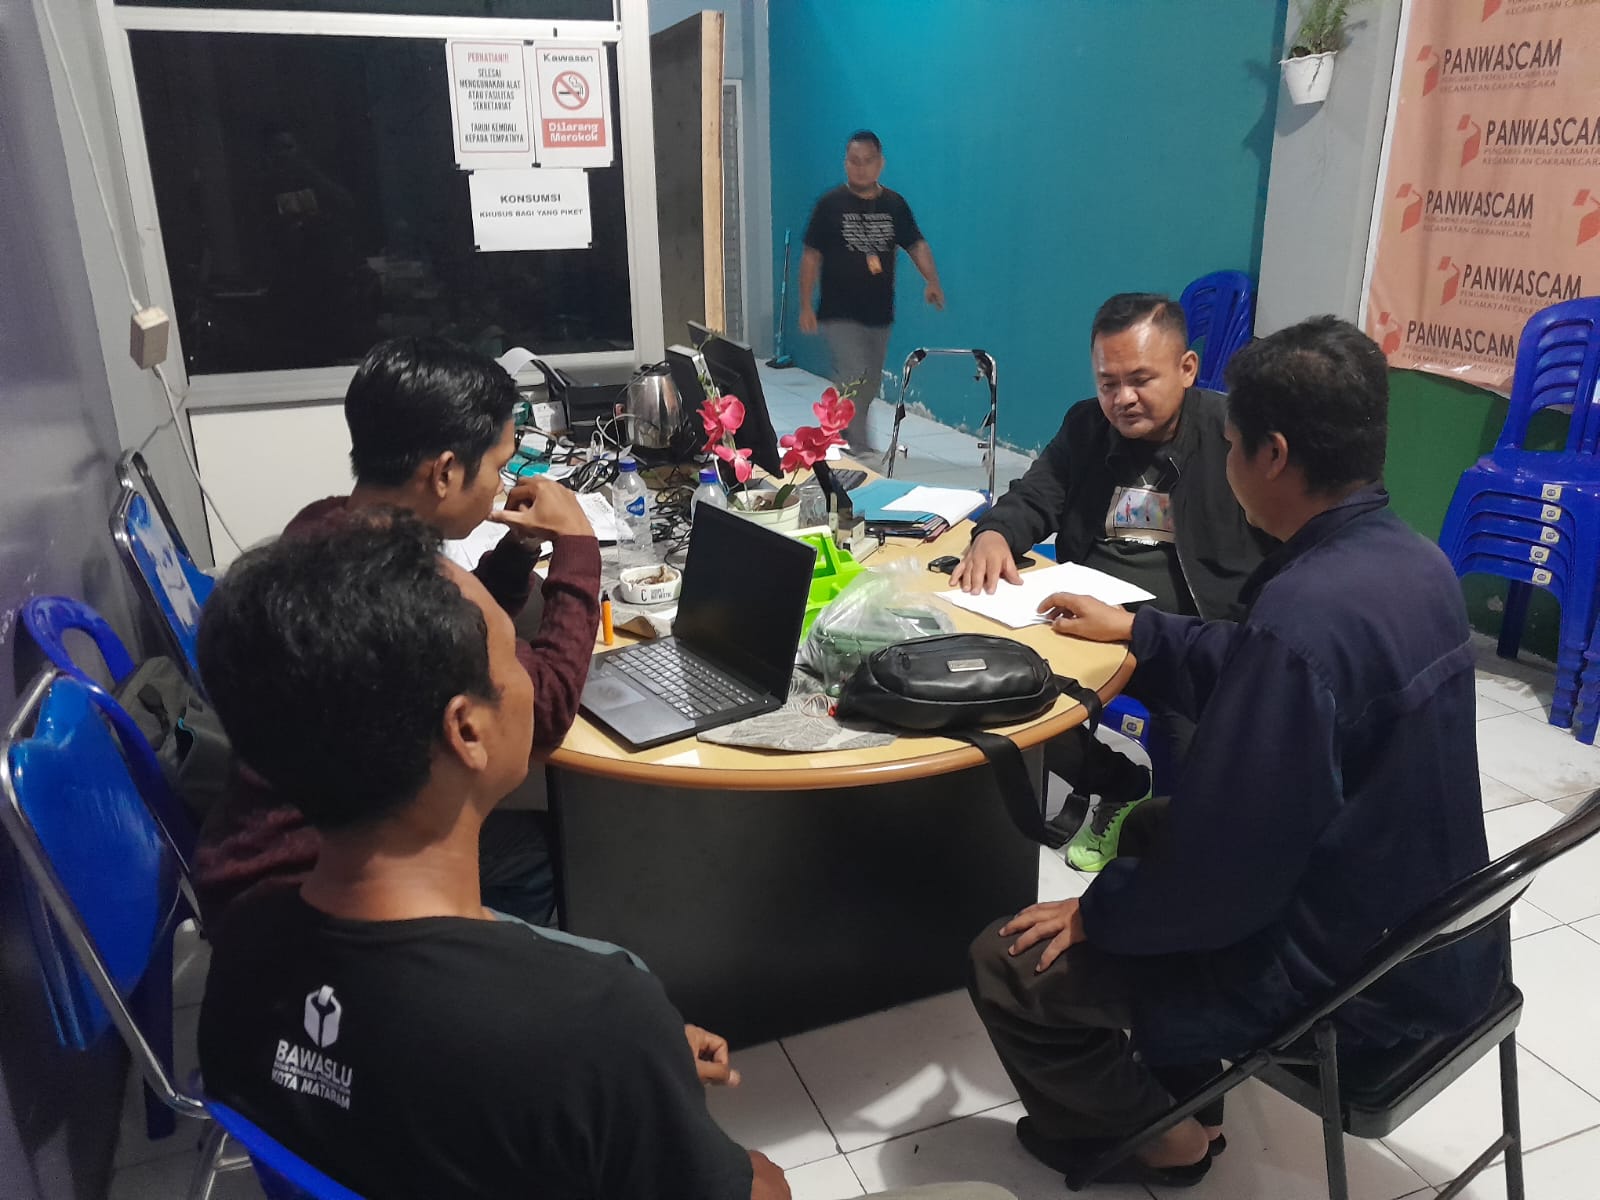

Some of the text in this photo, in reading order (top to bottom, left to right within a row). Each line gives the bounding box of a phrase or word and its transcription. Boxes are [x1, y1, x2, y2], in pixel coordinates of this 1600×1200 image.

[468, 52, 508, 63] PERHATIAN!!!
[543, 53, 594, 63] Kawasan
[1443, 38, 1562, 74] PANWASCAM
[478, 68, 501, 78] SELESAI
[460, 79, 520, 89] MENGGUNAKAN ALAT
[468, 90, 514, 100] ATAU FASILITAS
[473, 102, 511, 111] SEKRETARIAT
[492, 123, 517, 132] KEMBALI
[548, 122, 599, 132] Dilarang
[465, 134, 524, 143] KEPADA TEMPATNYA
[550, 132, 598, 143] Merokok
[500, 193, 561, 204] KONSUMSI
[1425, 190, 1534, 220] PANWASCAM
[480, 210, 513, 218] KHUSUS
[537, 209, 558, 217] YANG
[560, 208, 584, 216] PIKET
[1462, 264, 1581, 300] PANWASCAM
[1406, 320, 1515, 360] PANWASCAM
[276, 1039, 352, 1088] BAWASLU
[272, 1068, 298, 1091] KOTA
[301, 1078, 350, 1110] MATARAM
